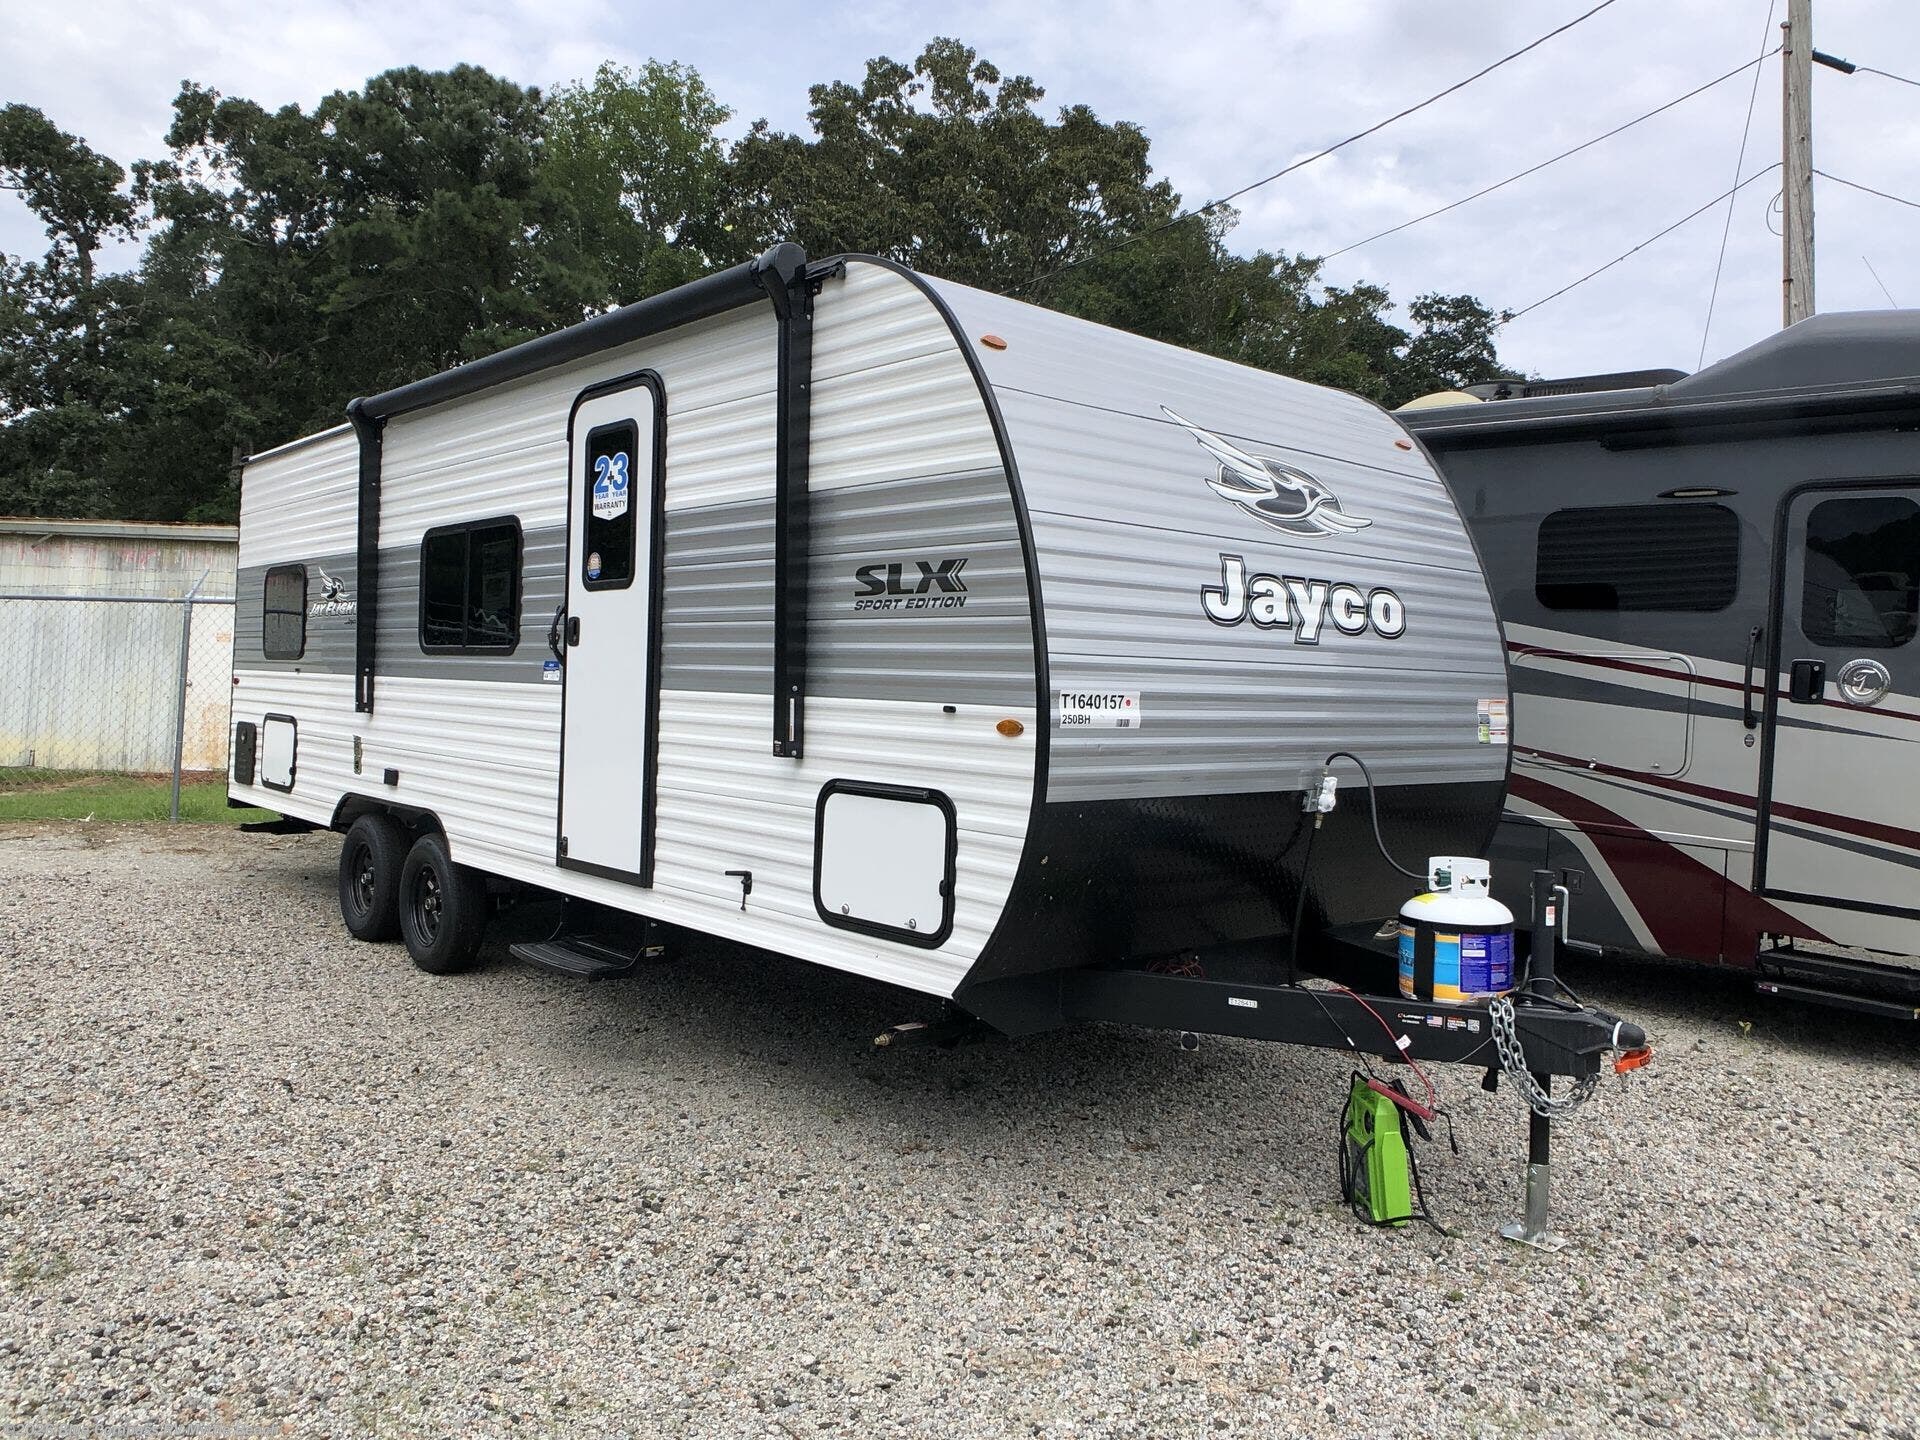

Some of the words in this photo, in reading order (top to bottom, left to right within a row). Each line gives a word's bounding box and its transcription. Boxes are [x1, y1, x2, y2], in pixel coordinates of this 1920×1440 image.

[612, 489, 627, 498] YEAR
[594, 501, 626, 511] WARRANTY
[854, 558, 969, 597] SLX
[854, 599, 903, 611] SPORT
[904, 596, 967, 609] EDITION
[1201, 552, 1406, 645] Jayco
[1061, 693, 1125, 709] T1640157
[1061, 714, 1091, 725] 250BH
